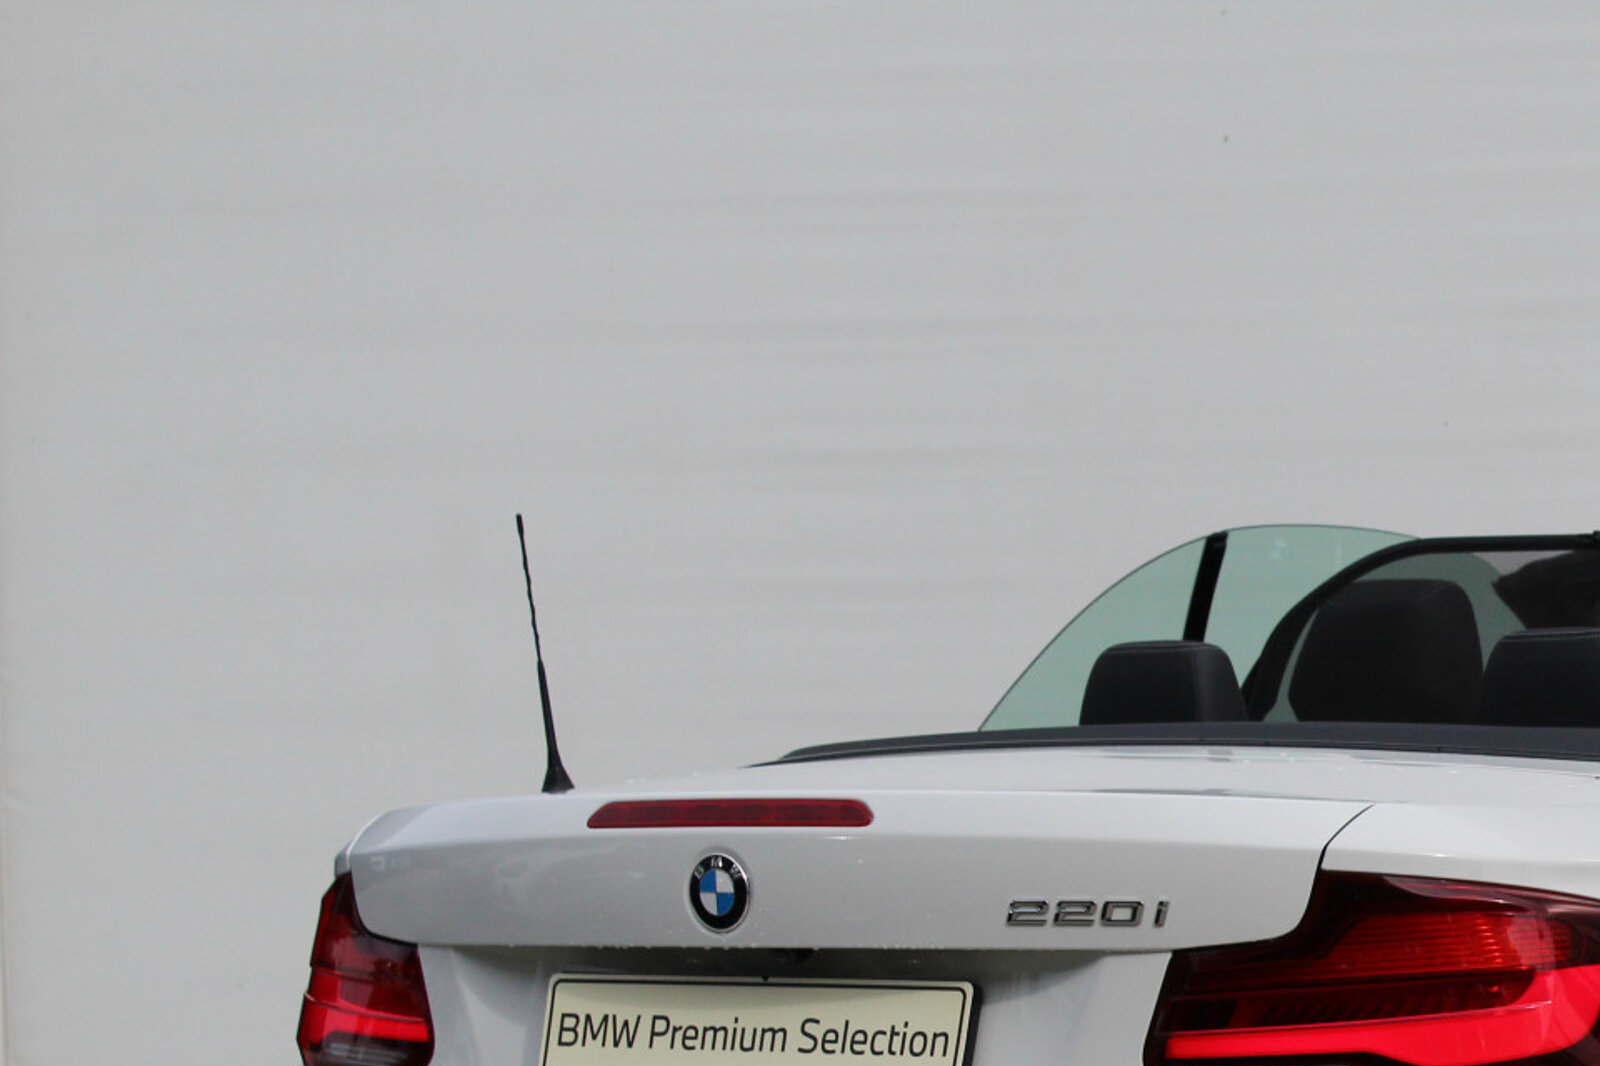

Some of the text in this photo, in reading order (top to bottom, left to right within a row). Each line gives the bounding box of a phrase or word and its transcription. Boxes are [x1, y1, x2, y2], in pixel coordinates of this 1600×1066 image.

[1006, 899, 1170, 928] 220i
[557, 1012, 950, 1058] BMW Premium Selection
